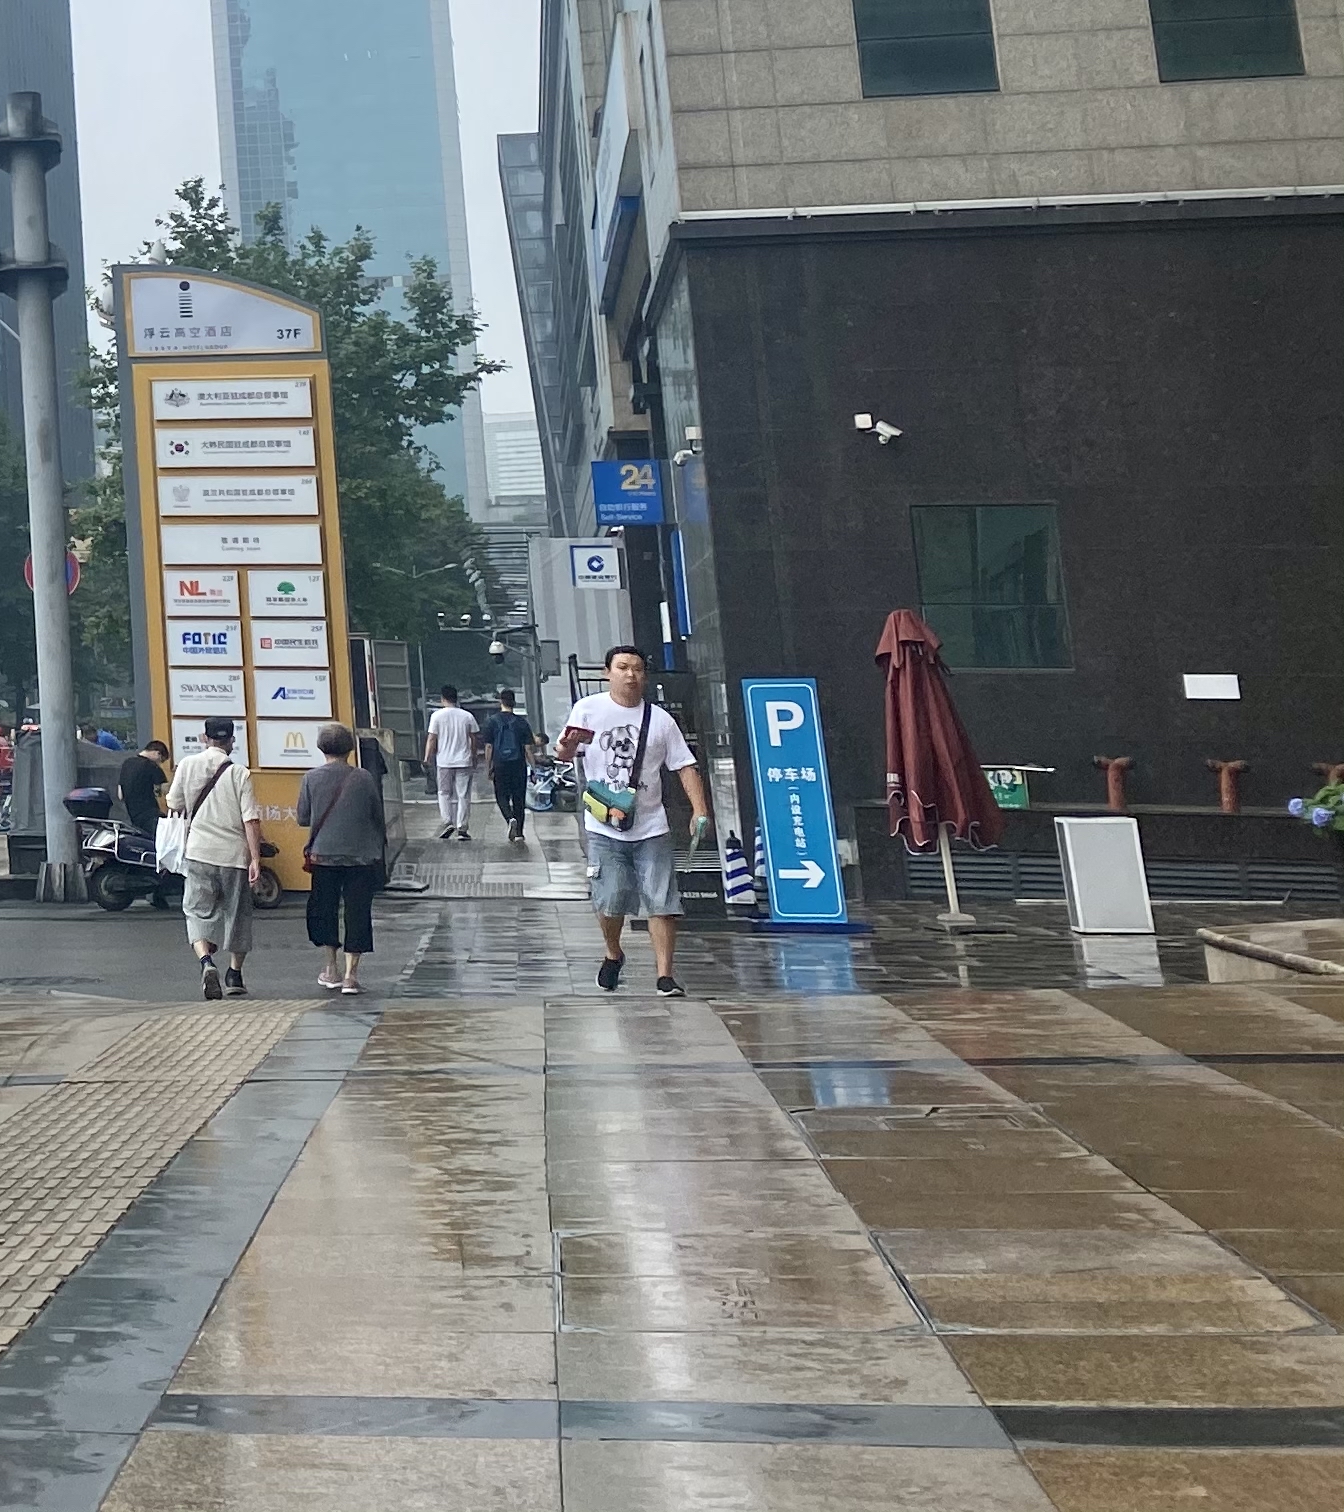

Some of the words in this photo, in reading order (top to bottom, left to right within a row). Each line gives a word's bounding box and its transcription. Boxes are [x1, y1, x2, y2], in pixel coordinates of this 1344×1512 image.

[277, 328, 301, 340] 37F
[620, 464, 656, 490] 24
[179, 580, 207, 596] NL
[182, 632, 228, 645] FOTIC
[765, 701, 805, 747] P
[767, 767, 816, 782] 停车场
